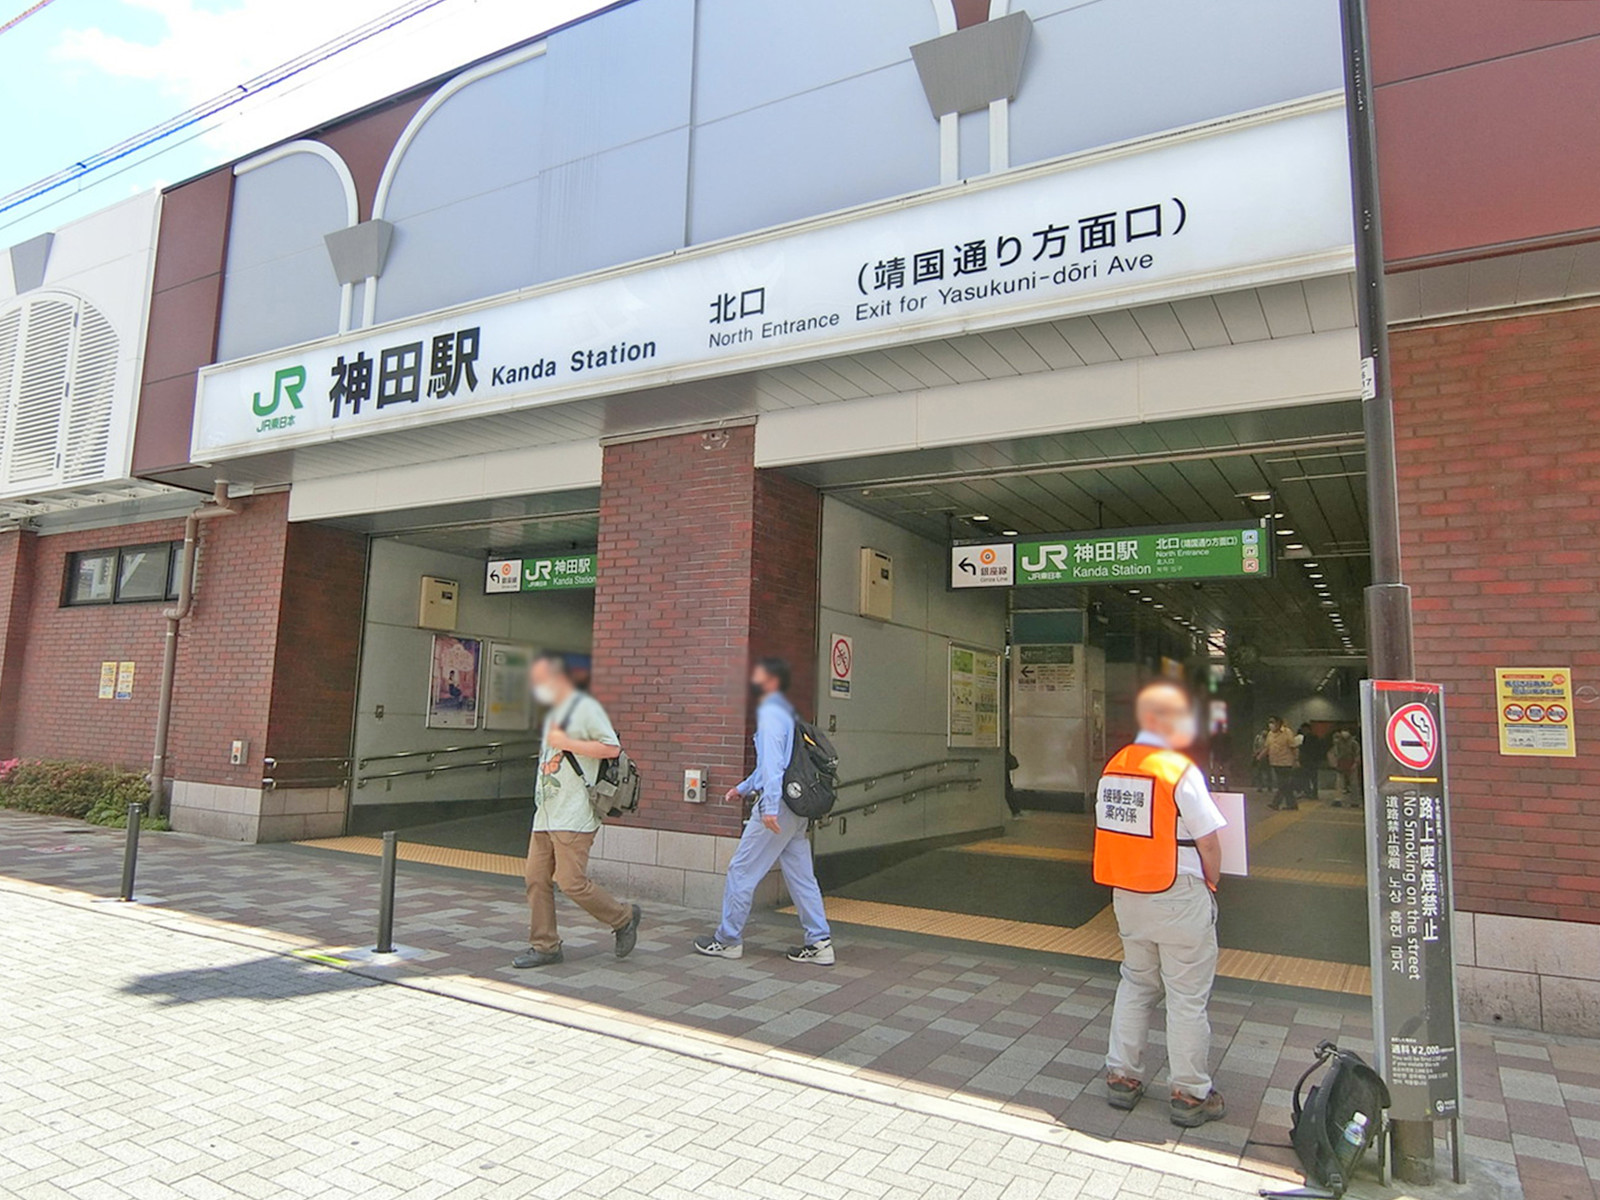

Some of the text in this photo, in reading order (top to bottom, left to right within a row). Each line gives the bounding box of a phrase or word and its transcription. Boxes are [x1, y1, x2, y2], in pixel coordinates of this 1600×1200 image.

[855, 252, 1153, 322] Exit for Yasukuni-dōri Ave
[708, 286, 766, 325] 北口
[708, 310, 840, 348] North Entrance
[329, 326, 481, 419] 神田駅
[491, 340, 656, 388] Kanda Station
[253, 365, 306, 416] JR
[1022, 544, 1068, 572] JR
[1073, 539, 1138, 563] 神田駅
[1177, 549, 1210, 557] Entrance
[525, 560, 552, 581] JR
[554, 558, 591, 575] 神田駅
[1073, 565, 1109, 579] Kanda
[1112, 562, 1151, 576] Station
[553, 577, 573, 586] Kanda
[1103, 788, 1145, 808] 接種会場
[1105, 805, 1137, 823] 案内係
[1419, 796, 1439, 941] 路上喫煙禁止
[1402, 796, 1421, 980] No Smoking on the street
